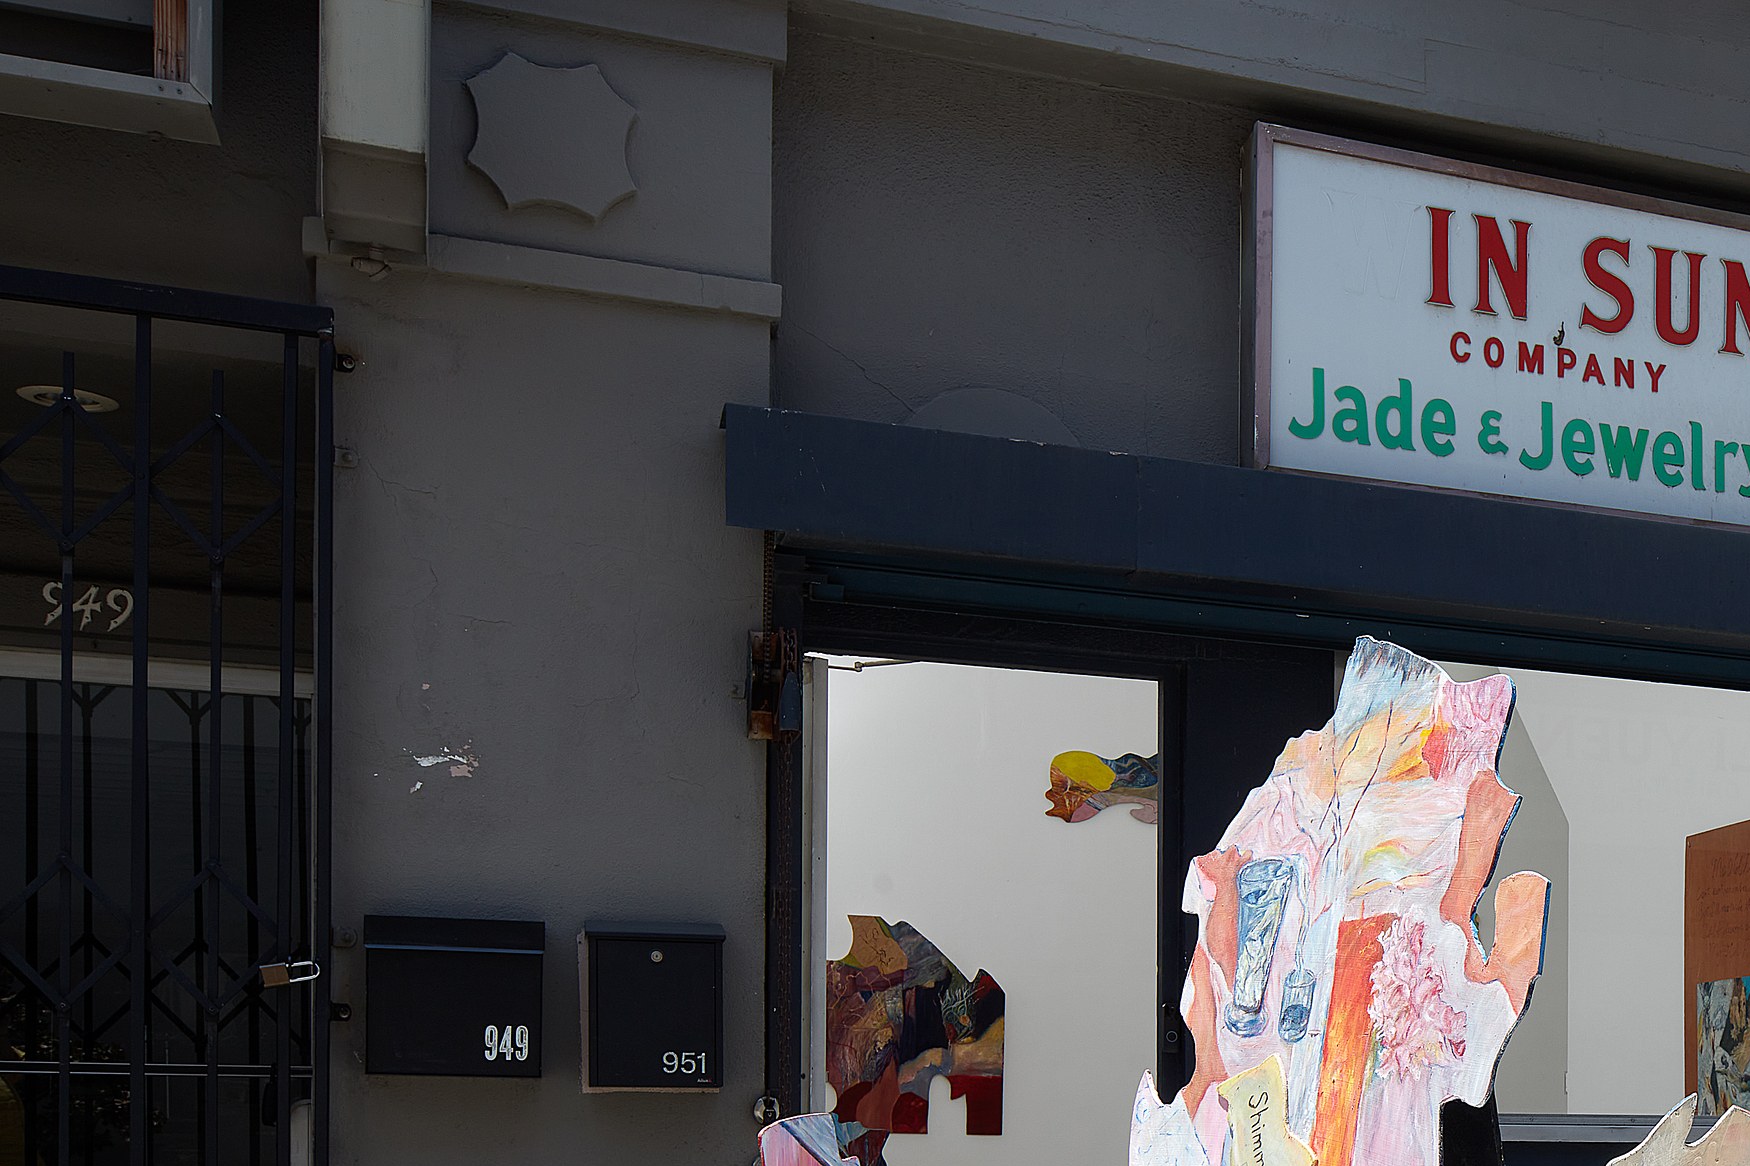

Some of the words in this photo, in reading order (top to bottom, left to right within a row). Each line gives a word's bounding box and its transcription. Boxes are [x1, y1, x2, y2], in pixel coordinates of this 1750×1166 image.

[1425, 206, 1533, 321] IN
[1449, 331, 1667, 393] COMPANY
[1288, 367, 1456, 457] Jade
[1477, 410, 1509, 455] &
[42, 581, 134, 632] 949
[484, 1025, 529, 1061] 949
[662, 1051, 706, 1074] 951
